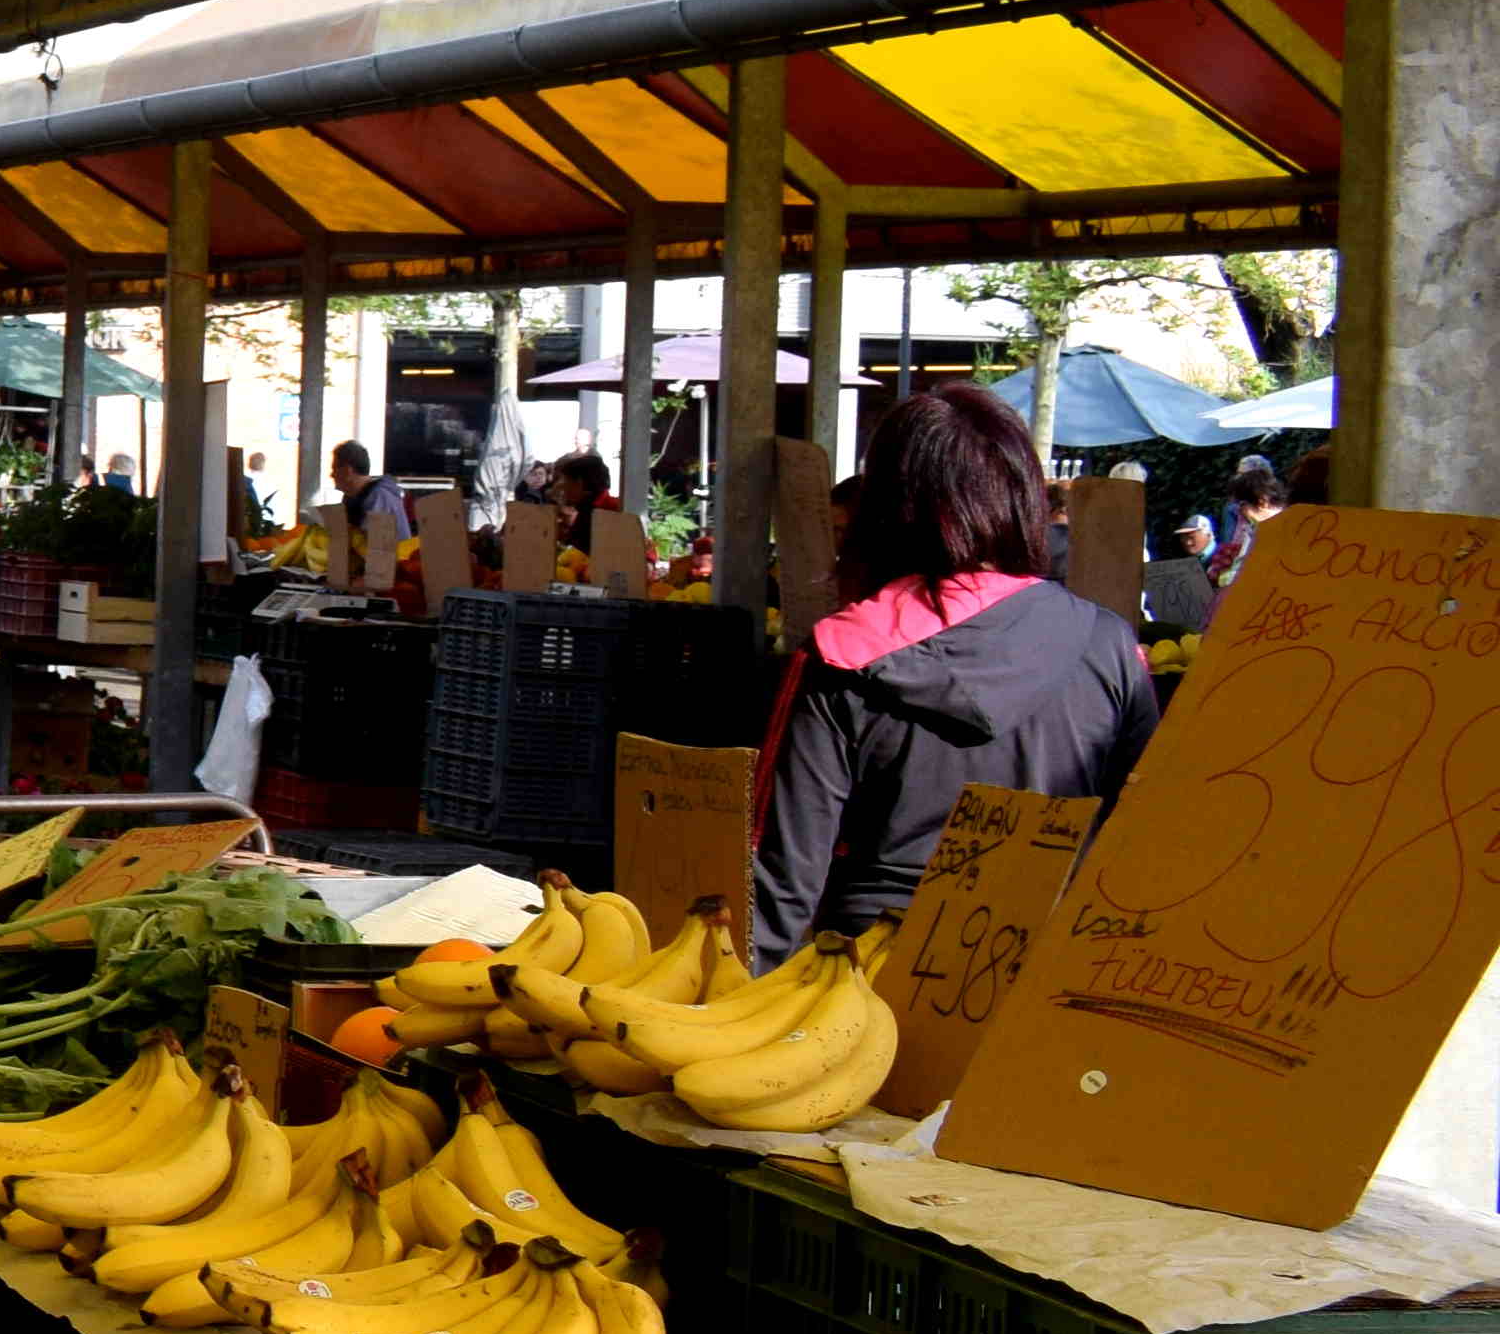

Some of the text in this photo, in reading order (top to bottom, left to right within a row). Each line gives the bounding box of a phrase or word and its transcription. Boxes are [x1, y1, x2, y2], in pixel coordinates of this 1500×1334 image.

[950, 788, 1021, 836] BANÁN
[1096, 644, 1500, 1000] 398
[909, 898, 1019, 1024] 498
